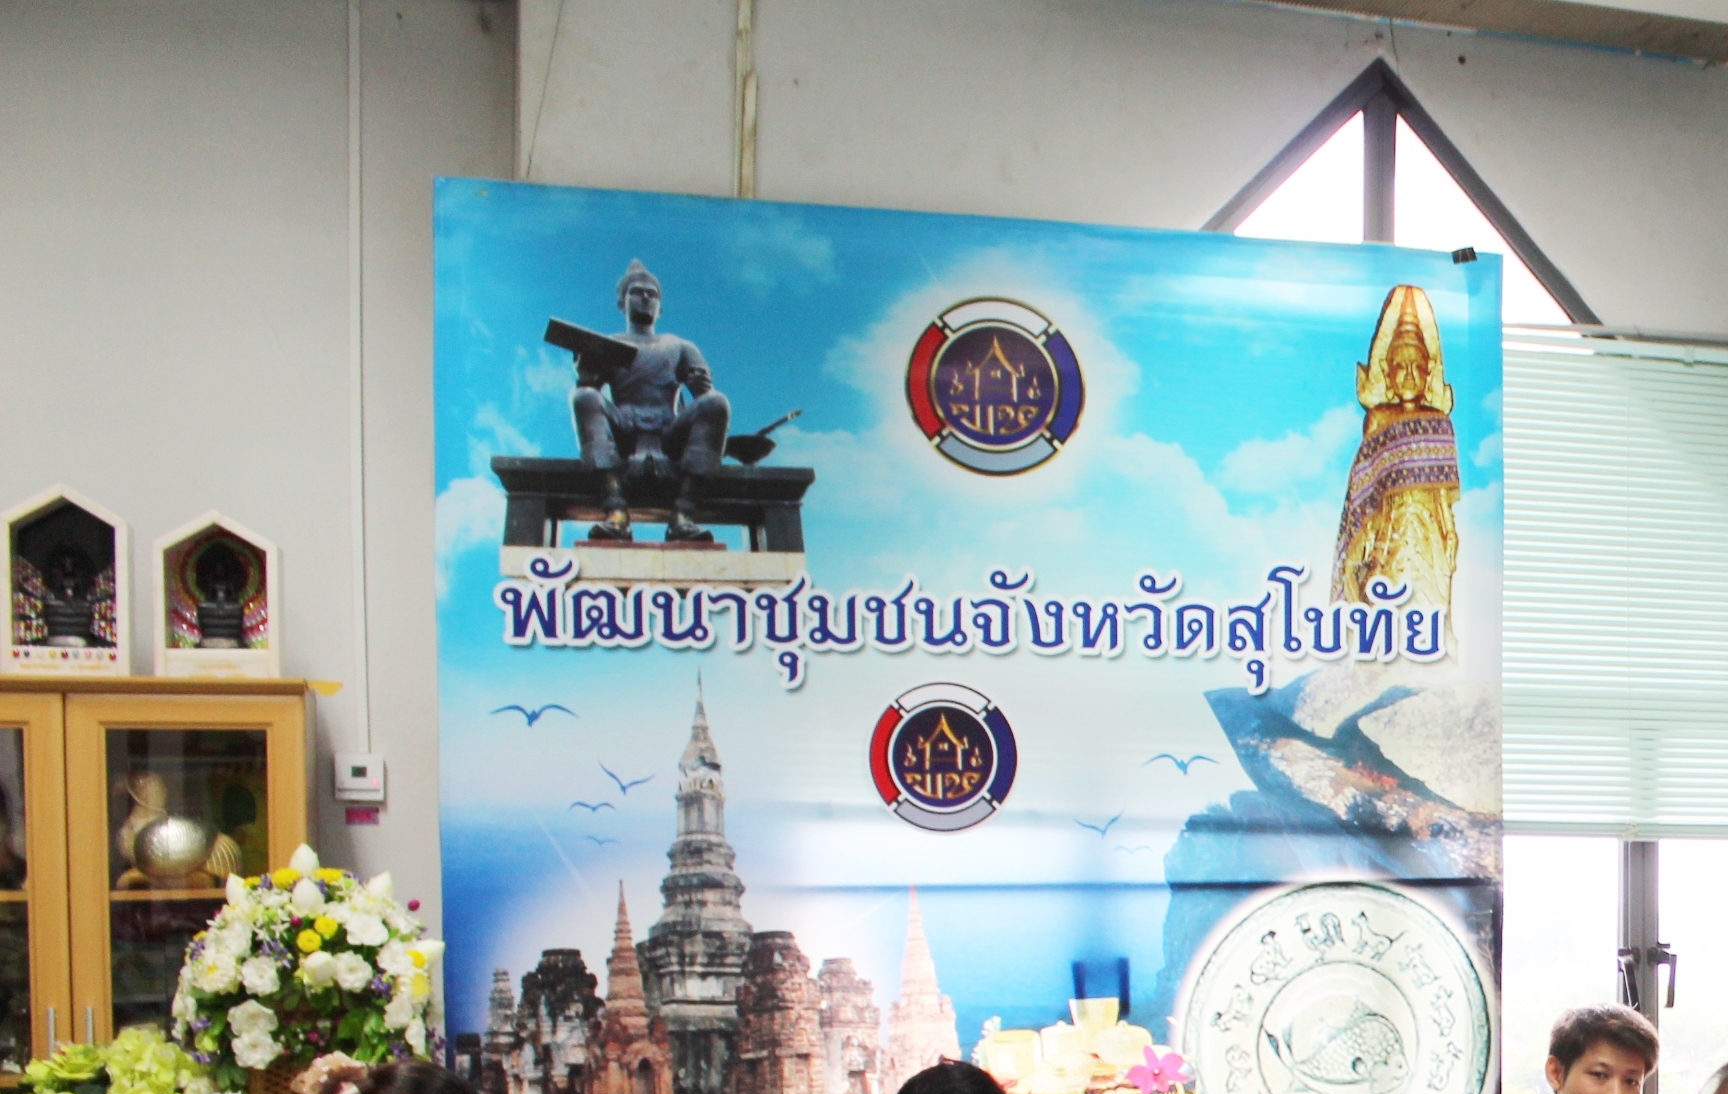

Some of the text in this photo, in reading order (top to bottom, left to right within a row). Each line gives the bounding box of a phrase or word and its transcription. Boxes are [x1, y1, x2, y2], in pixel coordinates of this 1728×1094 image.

[499, 556, 1442, 689] พัฒนาชุมชนจังหวัดสุโขทัย
